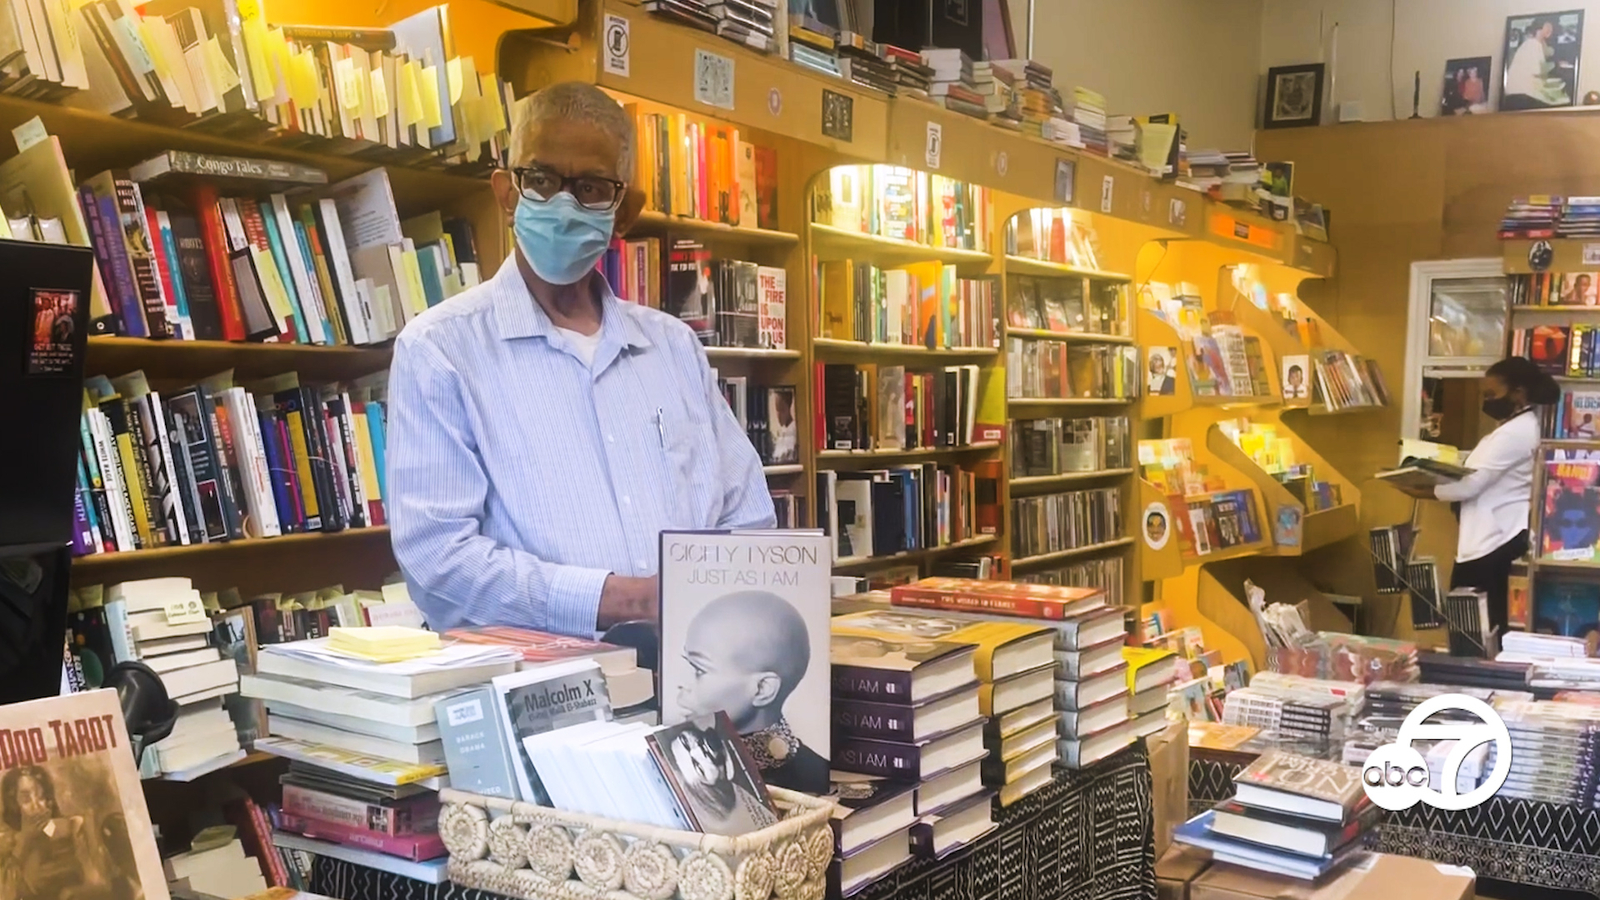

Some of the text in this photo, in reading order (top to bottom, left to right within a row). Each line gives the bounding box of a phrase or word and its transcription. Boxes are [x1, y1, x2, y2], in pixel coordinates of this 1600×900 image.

[197, 155, 233, 175] Congo
[236, 159, 262, 174] Tales
[760, 275, 775, 289] THE
[766, 290, 784, 303] FIRE
[761, 304, 769, 316] IS
[760, 317, 784, 330] UPON
[773, 332, 784, 344] US
[124, 412, 134, 431] WAY
[97, 439, 113, 483] WHITE RAGE
[135, 427, 144, 446] NEW
[142, 462, 154, 488] CROW
[670, 542, 817, 564] CICELY TYSON
[687, 568, 799, 586] JUST AS I AM
[858, 680, 880, 694] AM
[524, 679, 594, 713] Malcolm X
[566, 698, 597, 712] El-Shabazz
[860, 715, 882, 730] AM
[0, 714, 117, 770] DOO TAROT
[456, 731, 484, 743] BARACK
[460, 743, 486, 754] OBAMA
[866, 753, 887, 768] AM
